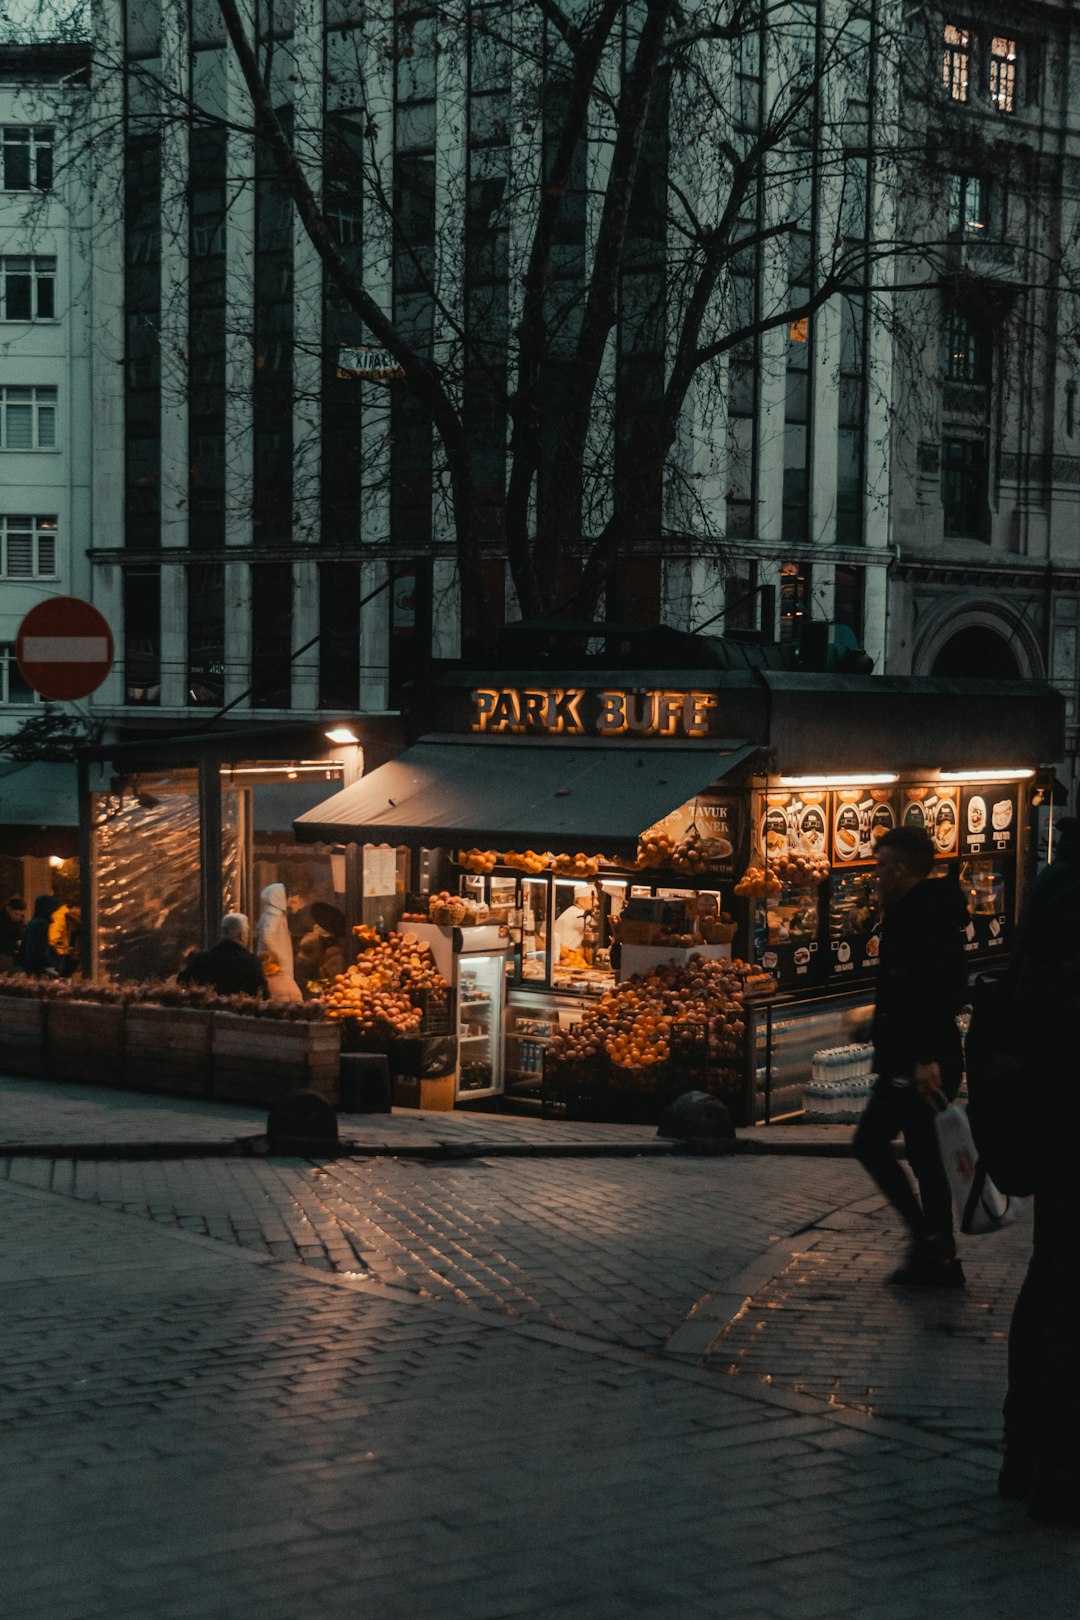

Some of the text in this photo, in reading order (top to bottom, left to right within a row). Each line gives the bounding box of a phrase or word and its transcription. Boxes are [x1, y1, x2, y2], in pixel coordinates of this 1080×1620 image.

[471, 688, 714, 734] PARK BÜFE
[688, 806, 728, 818] TAVUK
